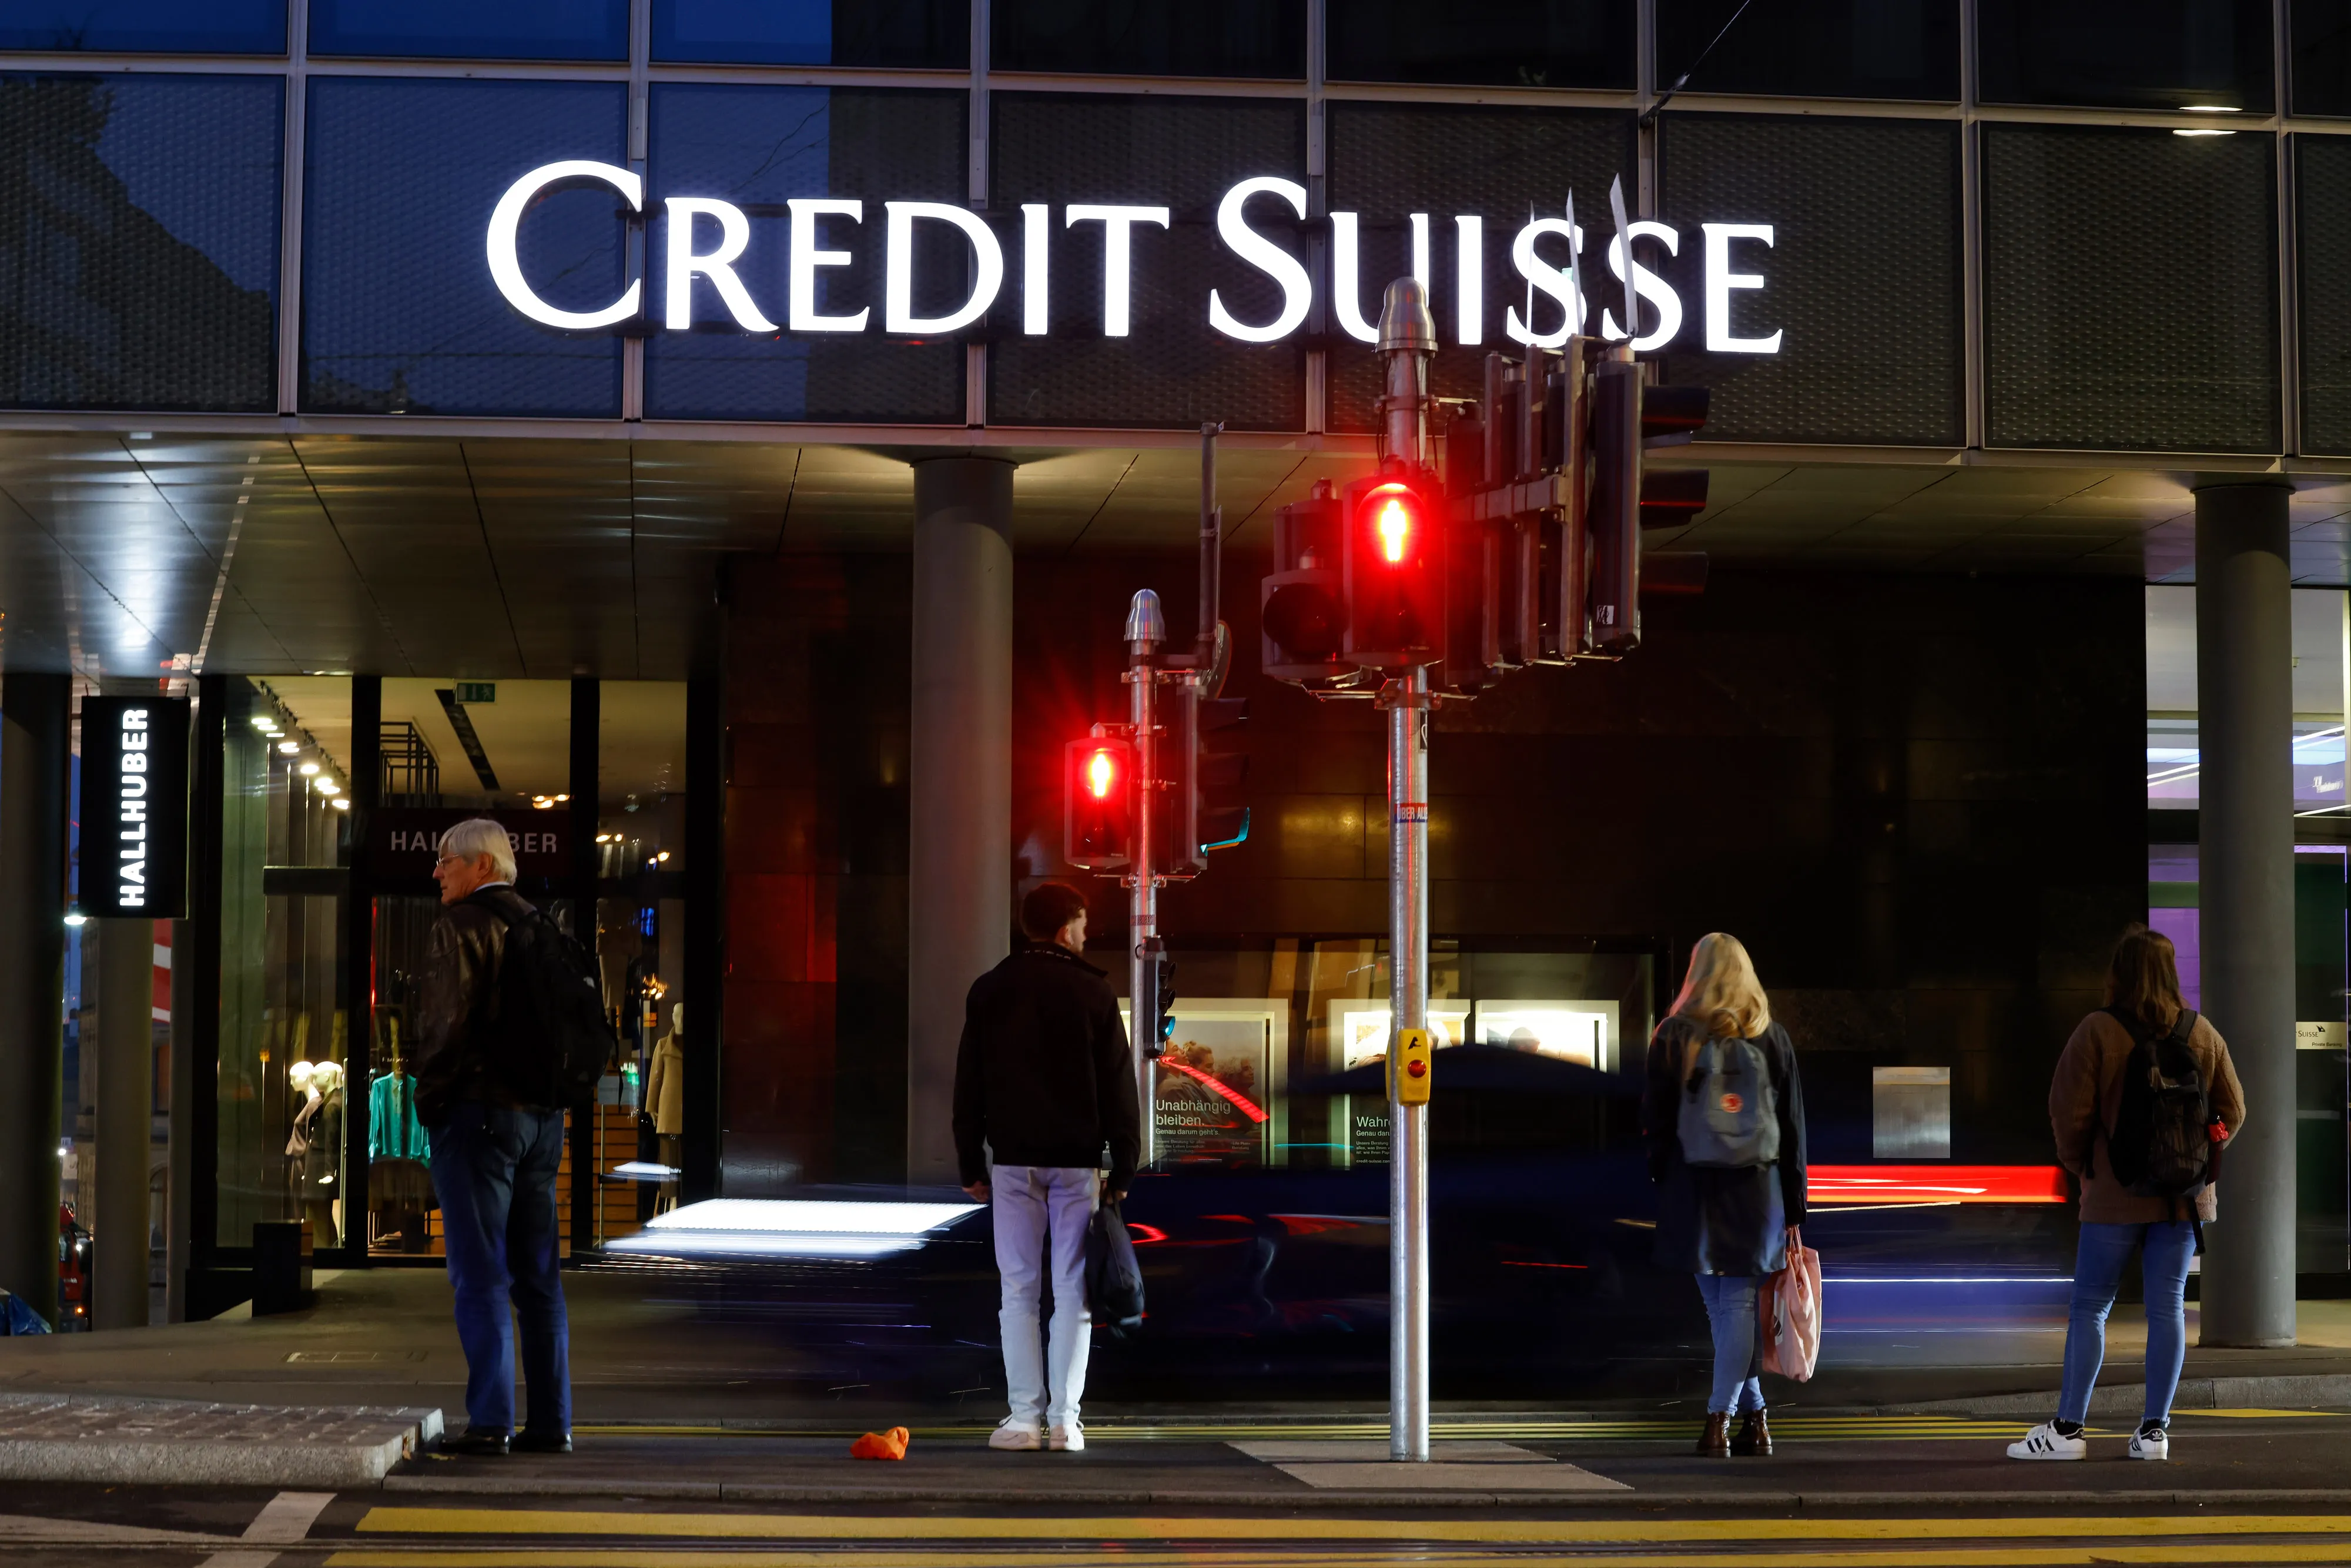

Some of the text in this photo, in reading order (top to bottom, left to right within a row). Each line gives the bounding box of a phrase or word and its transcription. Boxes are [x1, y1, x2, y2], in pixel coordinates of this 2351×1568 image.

[485, 159, 1784, 355] CREDIT SUISSE
[119, 709, 148, 907] HALLHUBER
[391, 830, 558, 853] HALBER
[1156, 1100, 1231, 1114] Unabhängig
[1156, 1114, 1205, 1125] bleiben.
[1357, 1116, 1390, 1127] Wahr
